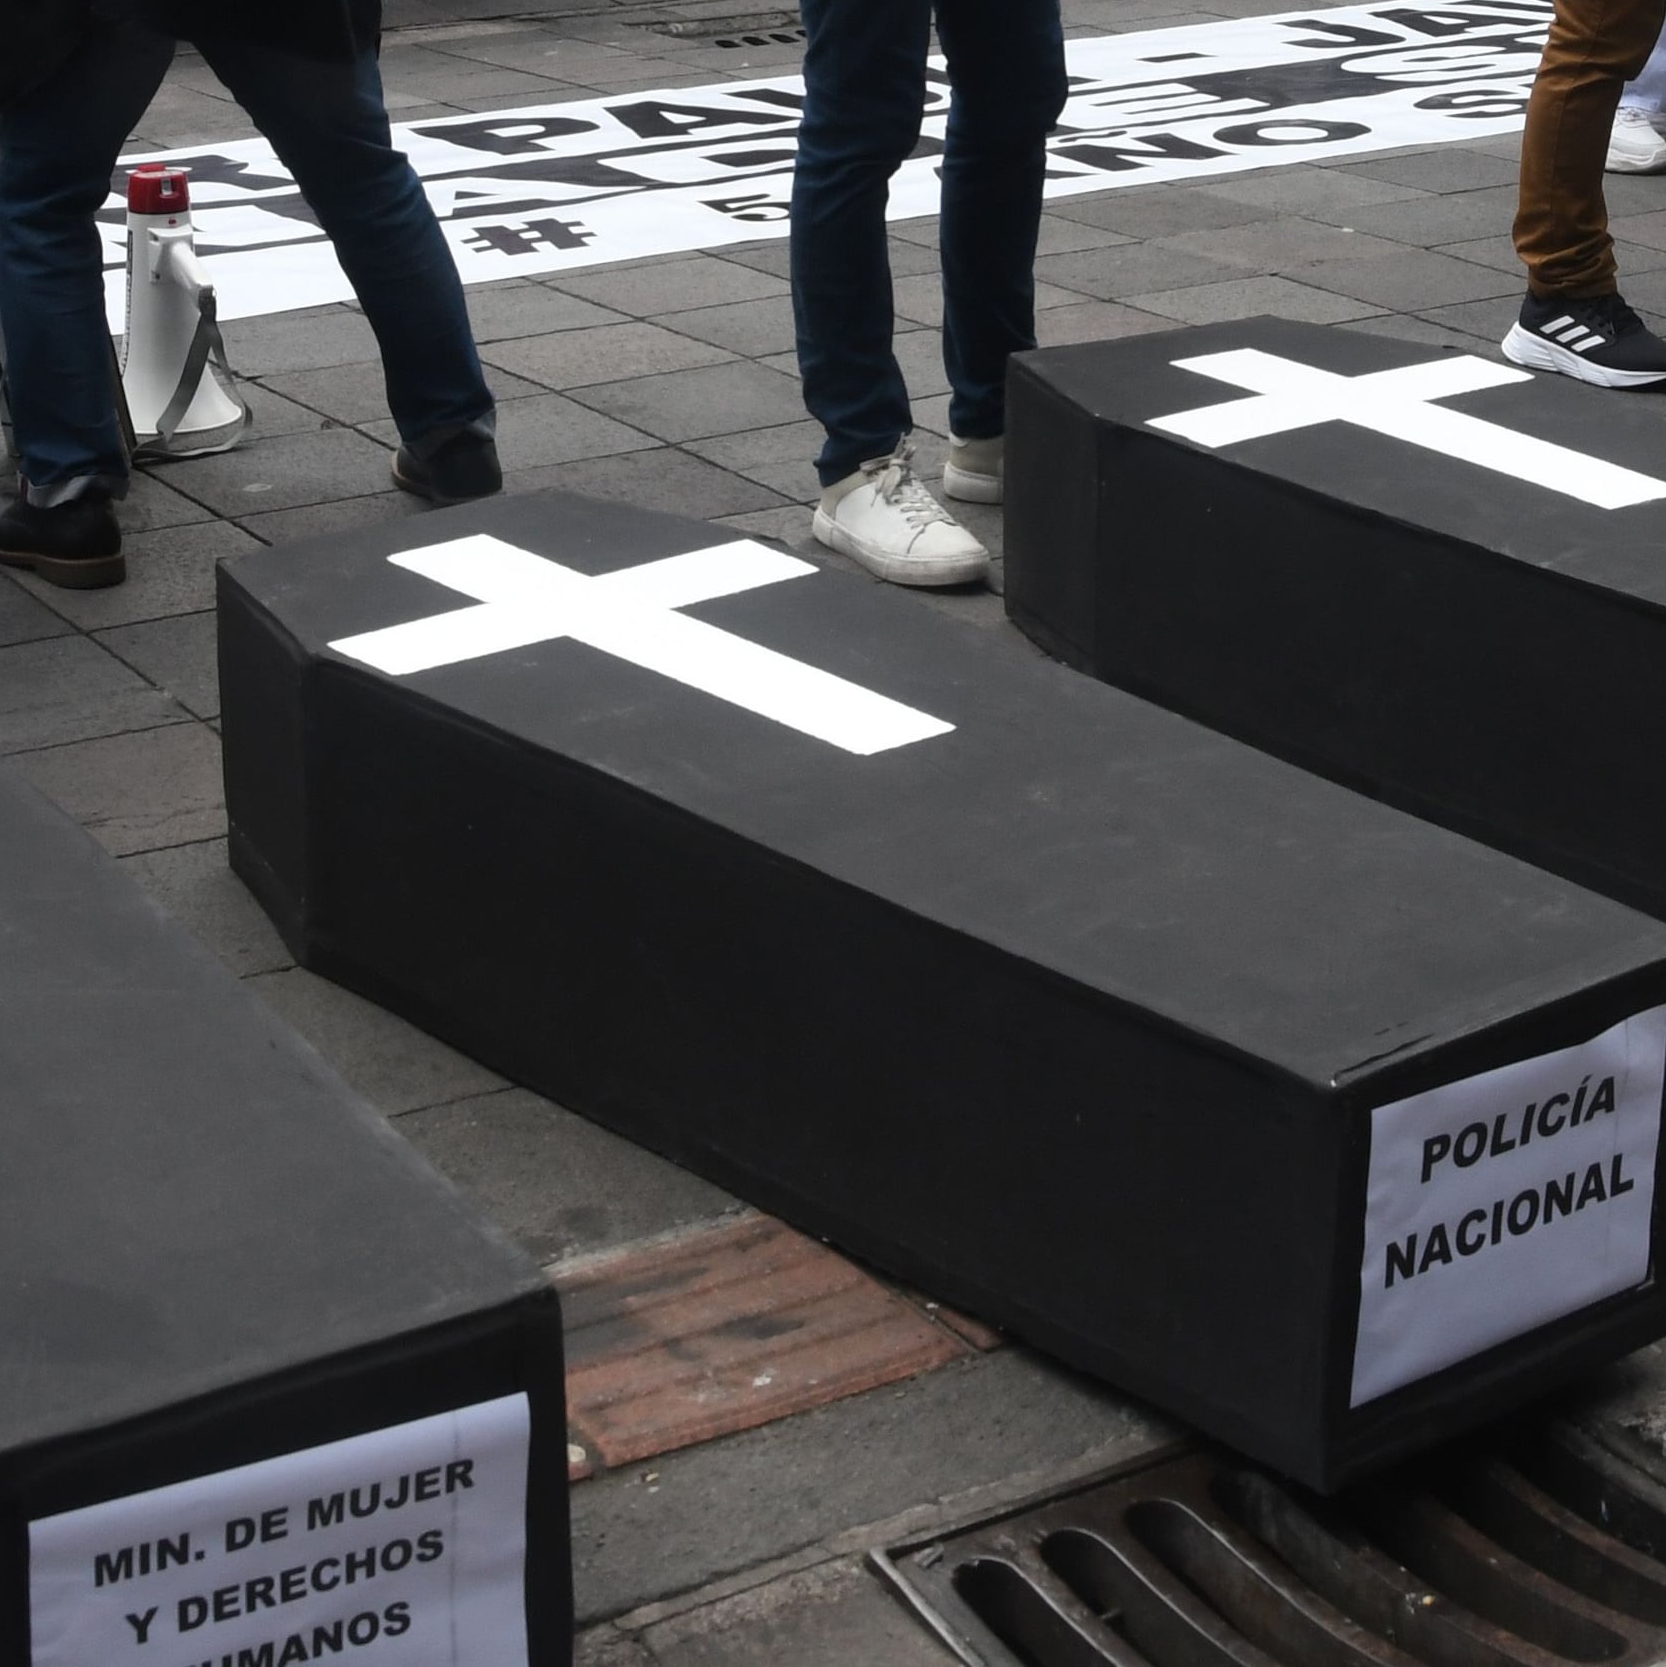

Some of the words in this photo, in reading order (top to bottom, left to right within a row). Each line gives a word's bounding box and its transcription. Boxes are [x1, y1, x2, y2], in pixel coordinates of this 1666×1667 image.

[1420, 1073, 1617, 1184] POLICÍA
[1383, 1152, 1636, 1289] NACIONAL
[92, 1532, 206, 1588] MIN.
[224, 1507, 290, 1553] DE
[305, 1458, 475, 1531] MUJER
[125, 1606, 160, 1645] Y
[177, 1528, 446, 1633] DERECHOS
[188, 1601, 412, 1667] MANOS
